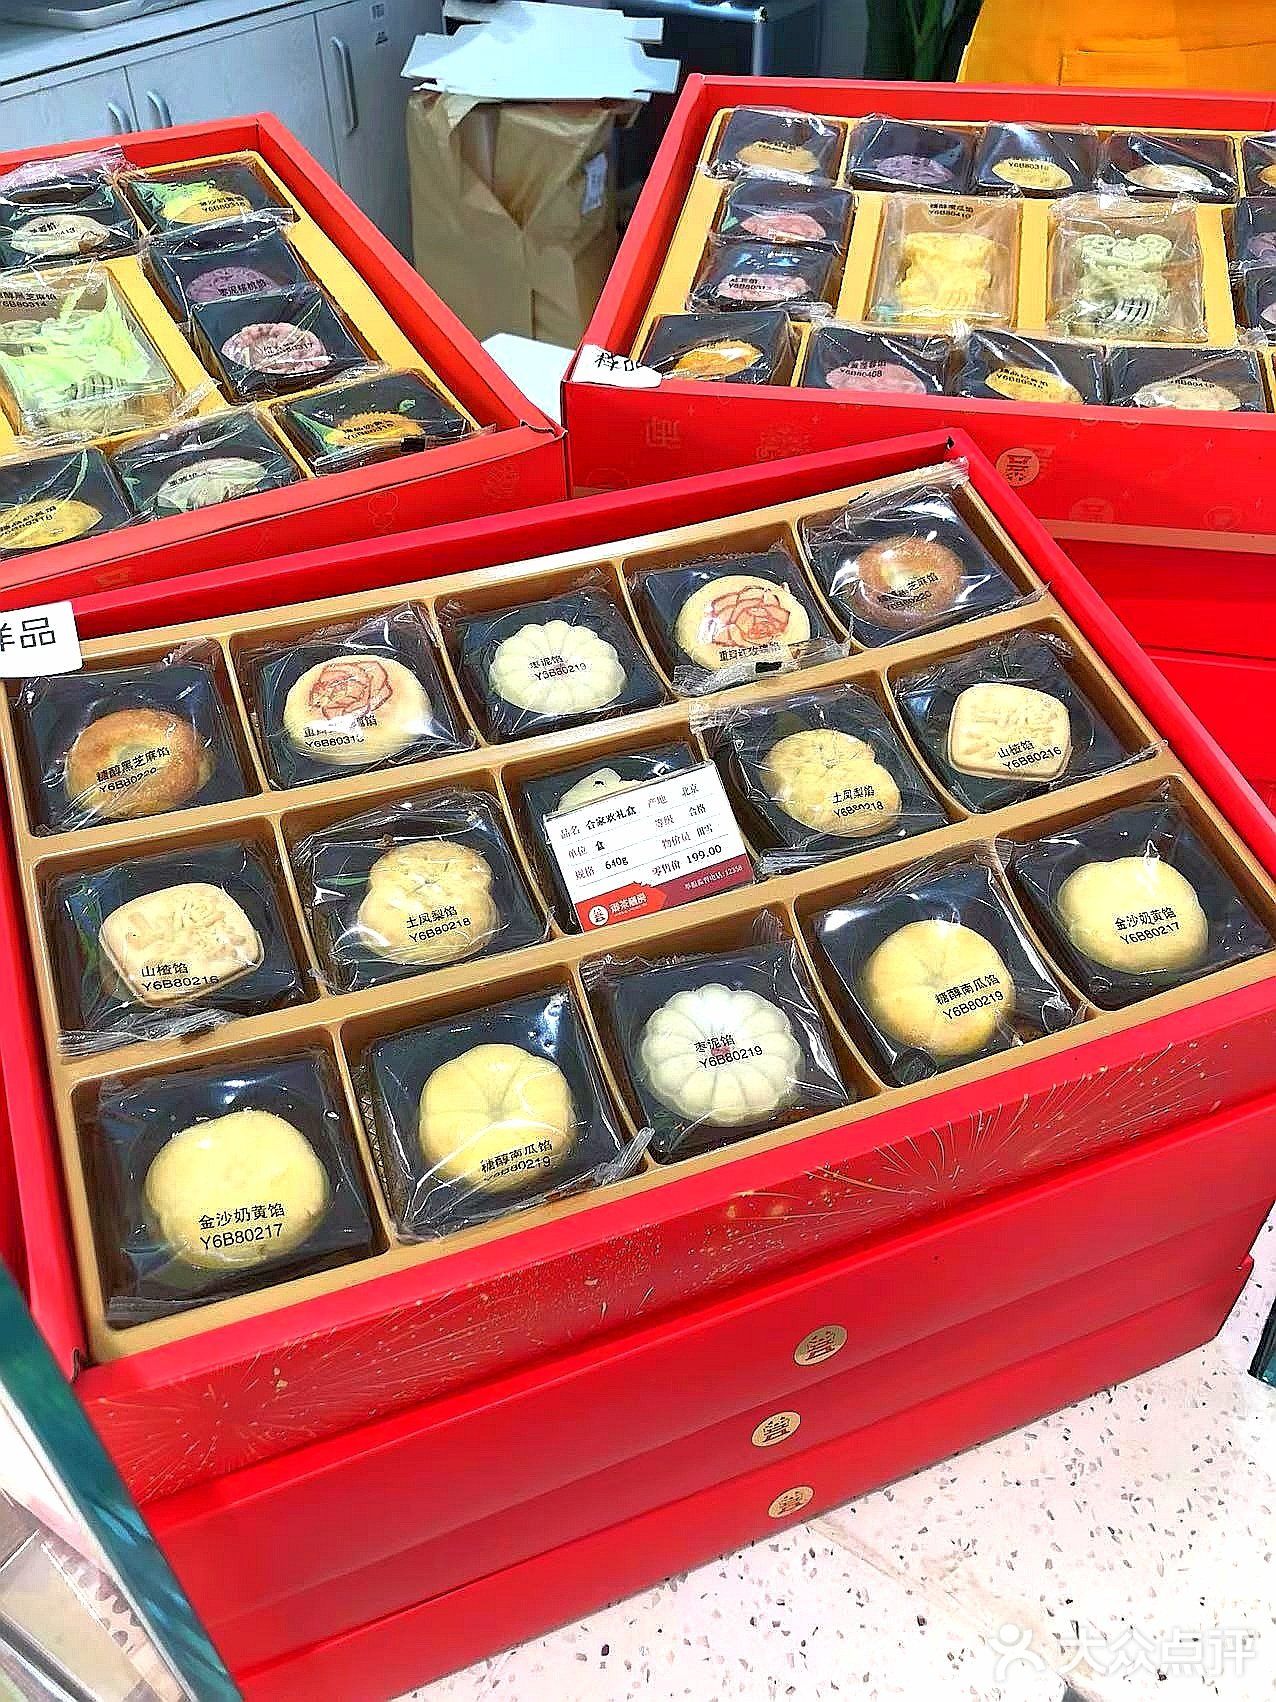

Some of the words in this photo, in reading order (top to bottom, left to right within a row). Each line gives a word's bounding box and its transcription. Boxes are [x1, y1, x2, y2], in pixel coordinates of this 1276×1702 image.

[998, 740, 1036, 759] 山楂馅
[1004, 747, 1062, 772] Y6B80216
[95, 746, 171, 784] 糖醇黑芝麻馅
[833, 785, 875, 804] 土凤梨馅
[561, 824, 582, 840] 品名
[586, 806, 637, 830] 合家欢礼盒
[681, 783, 700, 798] 北京
[568, 846, 588, 859] 单位
[595, 840, 607, 851] 盒
[688, 803, 706, 817] 合格
[605, 855, 629, 871] 640g
[651, 859, 682, 877] 零售价
[686, 844, 723, 865] 199.00
[405, 907, 459, 930] 土凤梨馅
[408, 917, 471, 944] Y6B80218
[1114, 907, 1178, 931] 金沙奶黄馅
[1120, 922, 1180, 945] Y6B80217
[141, 963, 190, 979] 山楂馅
[142, 975, 220, 994] Y6B80216
[935, 975, 1001, 1006] 糖醇南瓜馅
[942, 991, 1004, 1021] Y6B80219
[694, 1034, 736, 1053] 枣泥馅
[699, 1045, 763, 1069] Y6B80219
[480, 1139, 553, 1173] 糖醇南瓜馅
[199, 1201, 286, 1231] 金沙奶黄馅
[200, 1223, 283, 1251] Y6B80217
